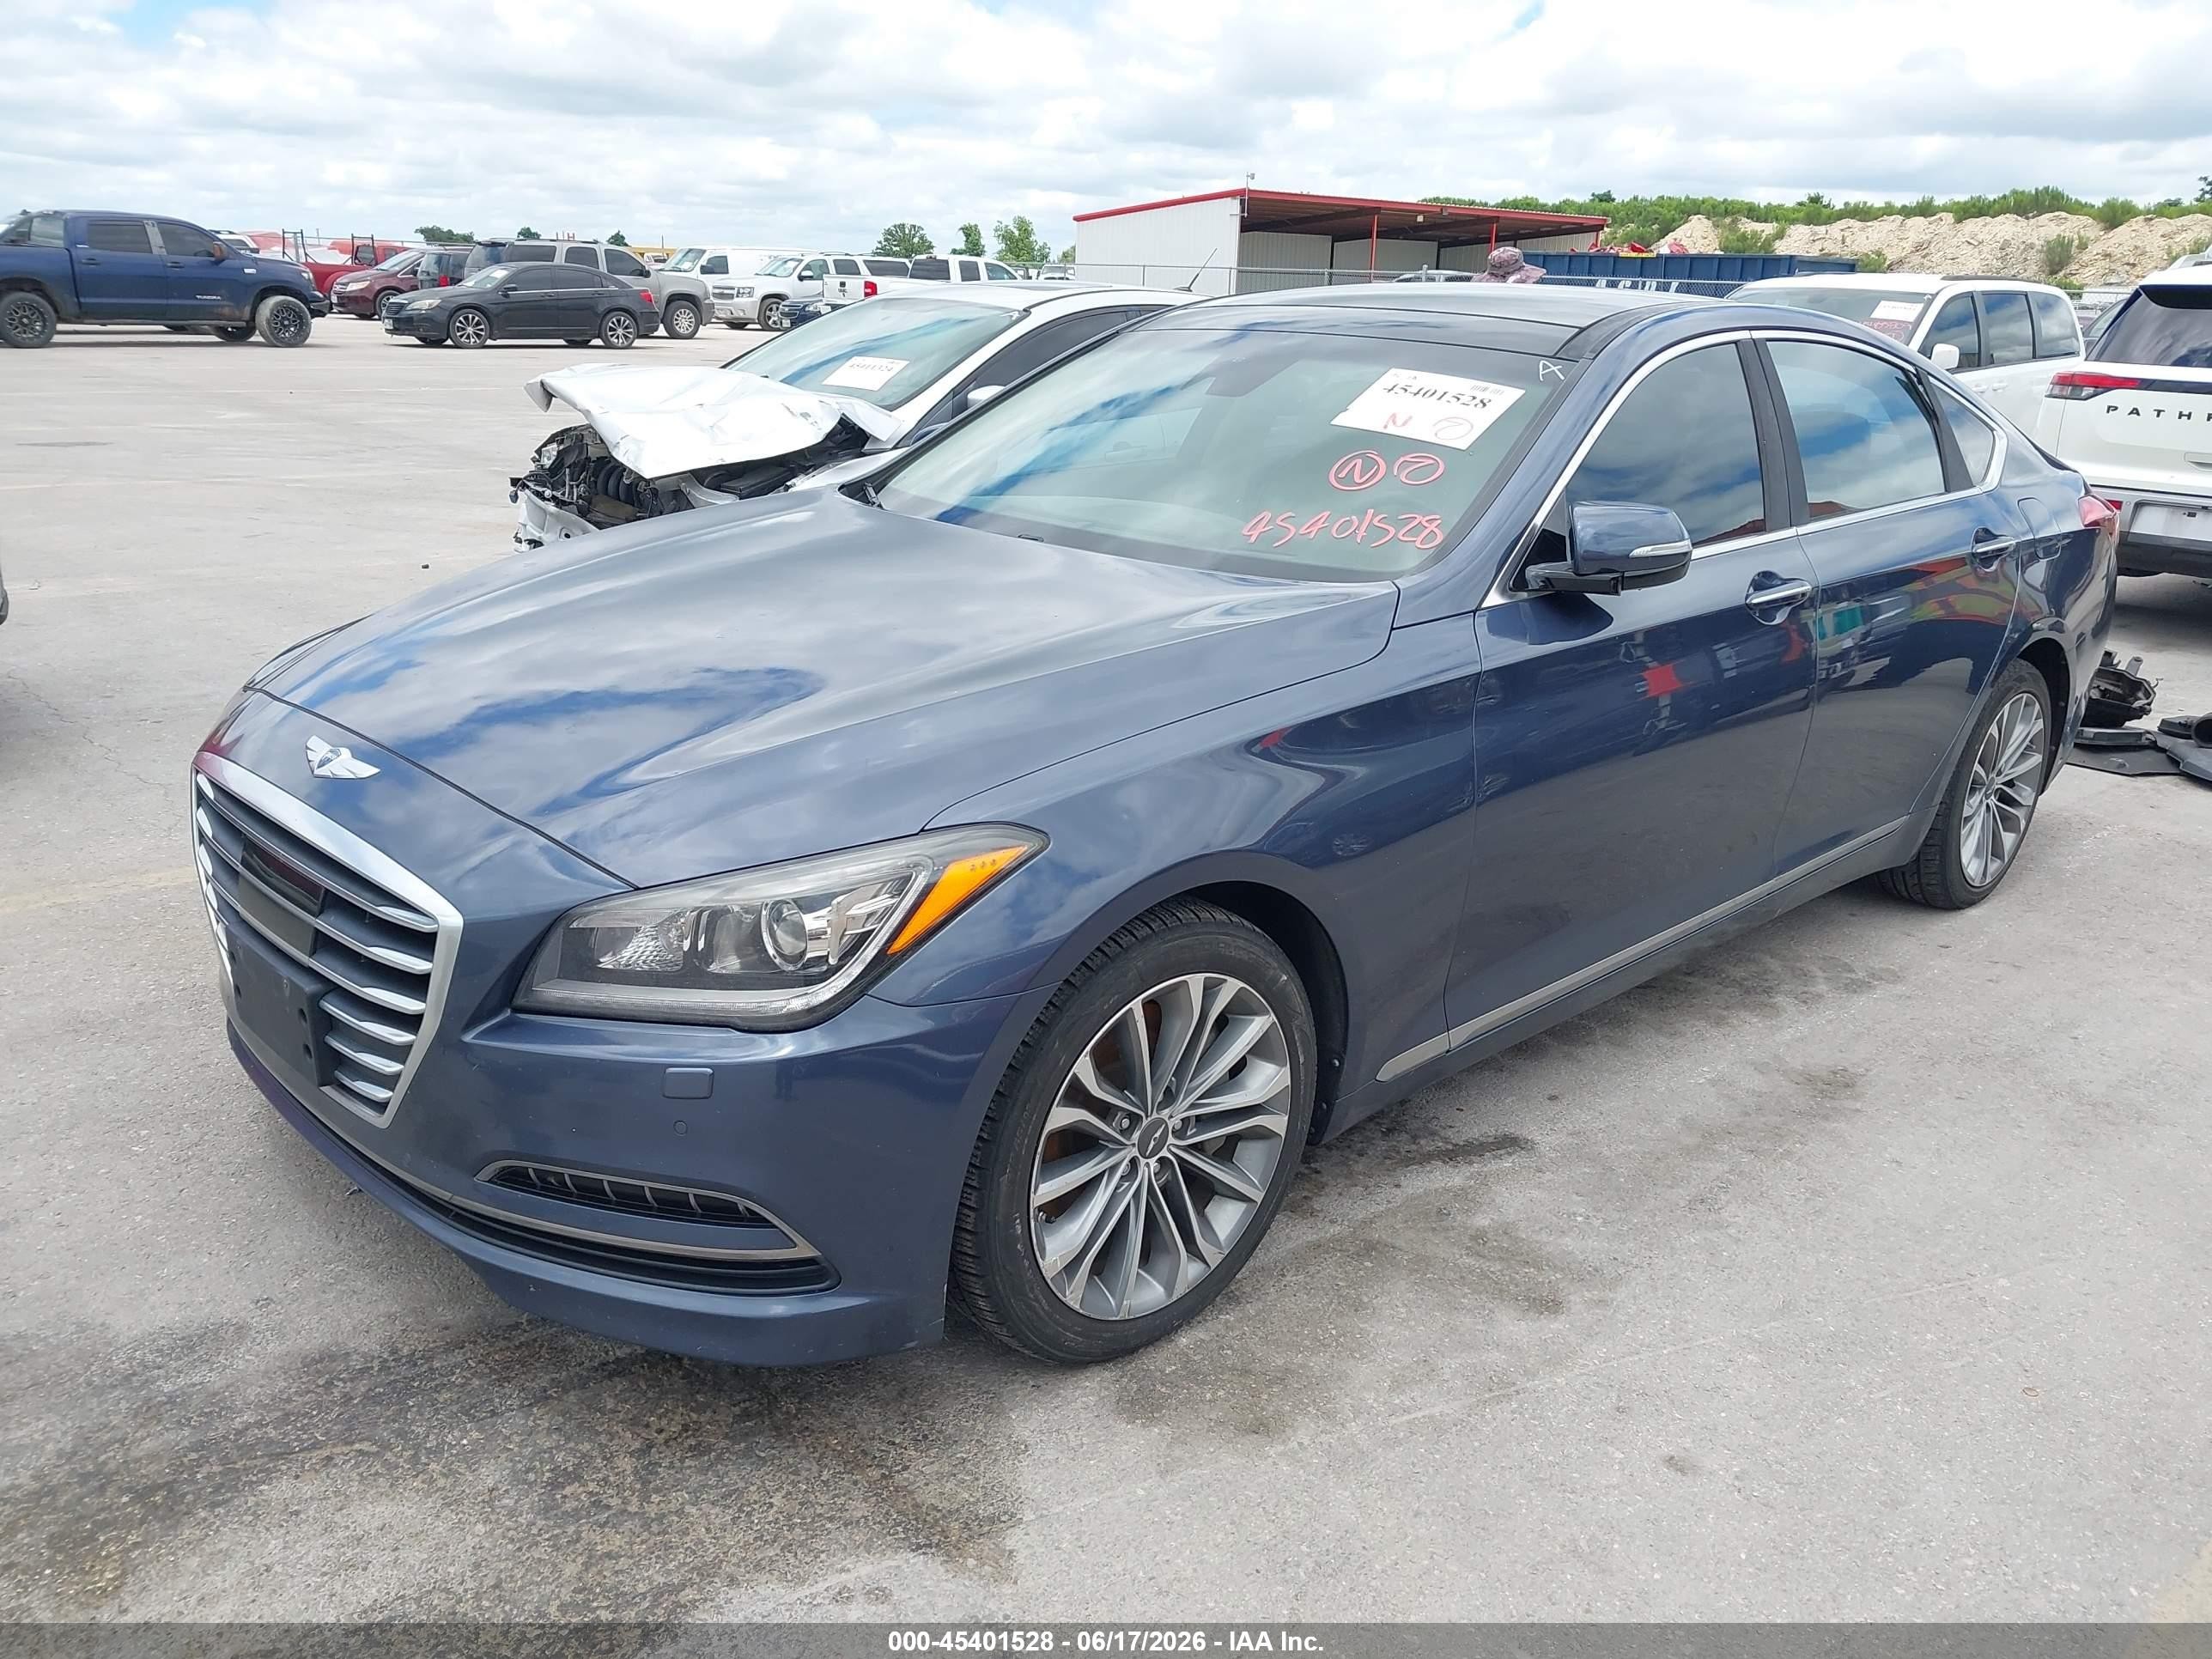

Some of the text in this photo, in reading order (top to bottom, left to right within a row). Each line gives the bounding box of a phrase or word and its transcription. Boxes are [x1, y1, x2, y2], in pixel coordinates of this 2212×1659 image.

[1539, 360, 1565, 382] A
[1382, 383, 1493, 410] 45401528
[1242, 509, 1444, 550] 45401528
